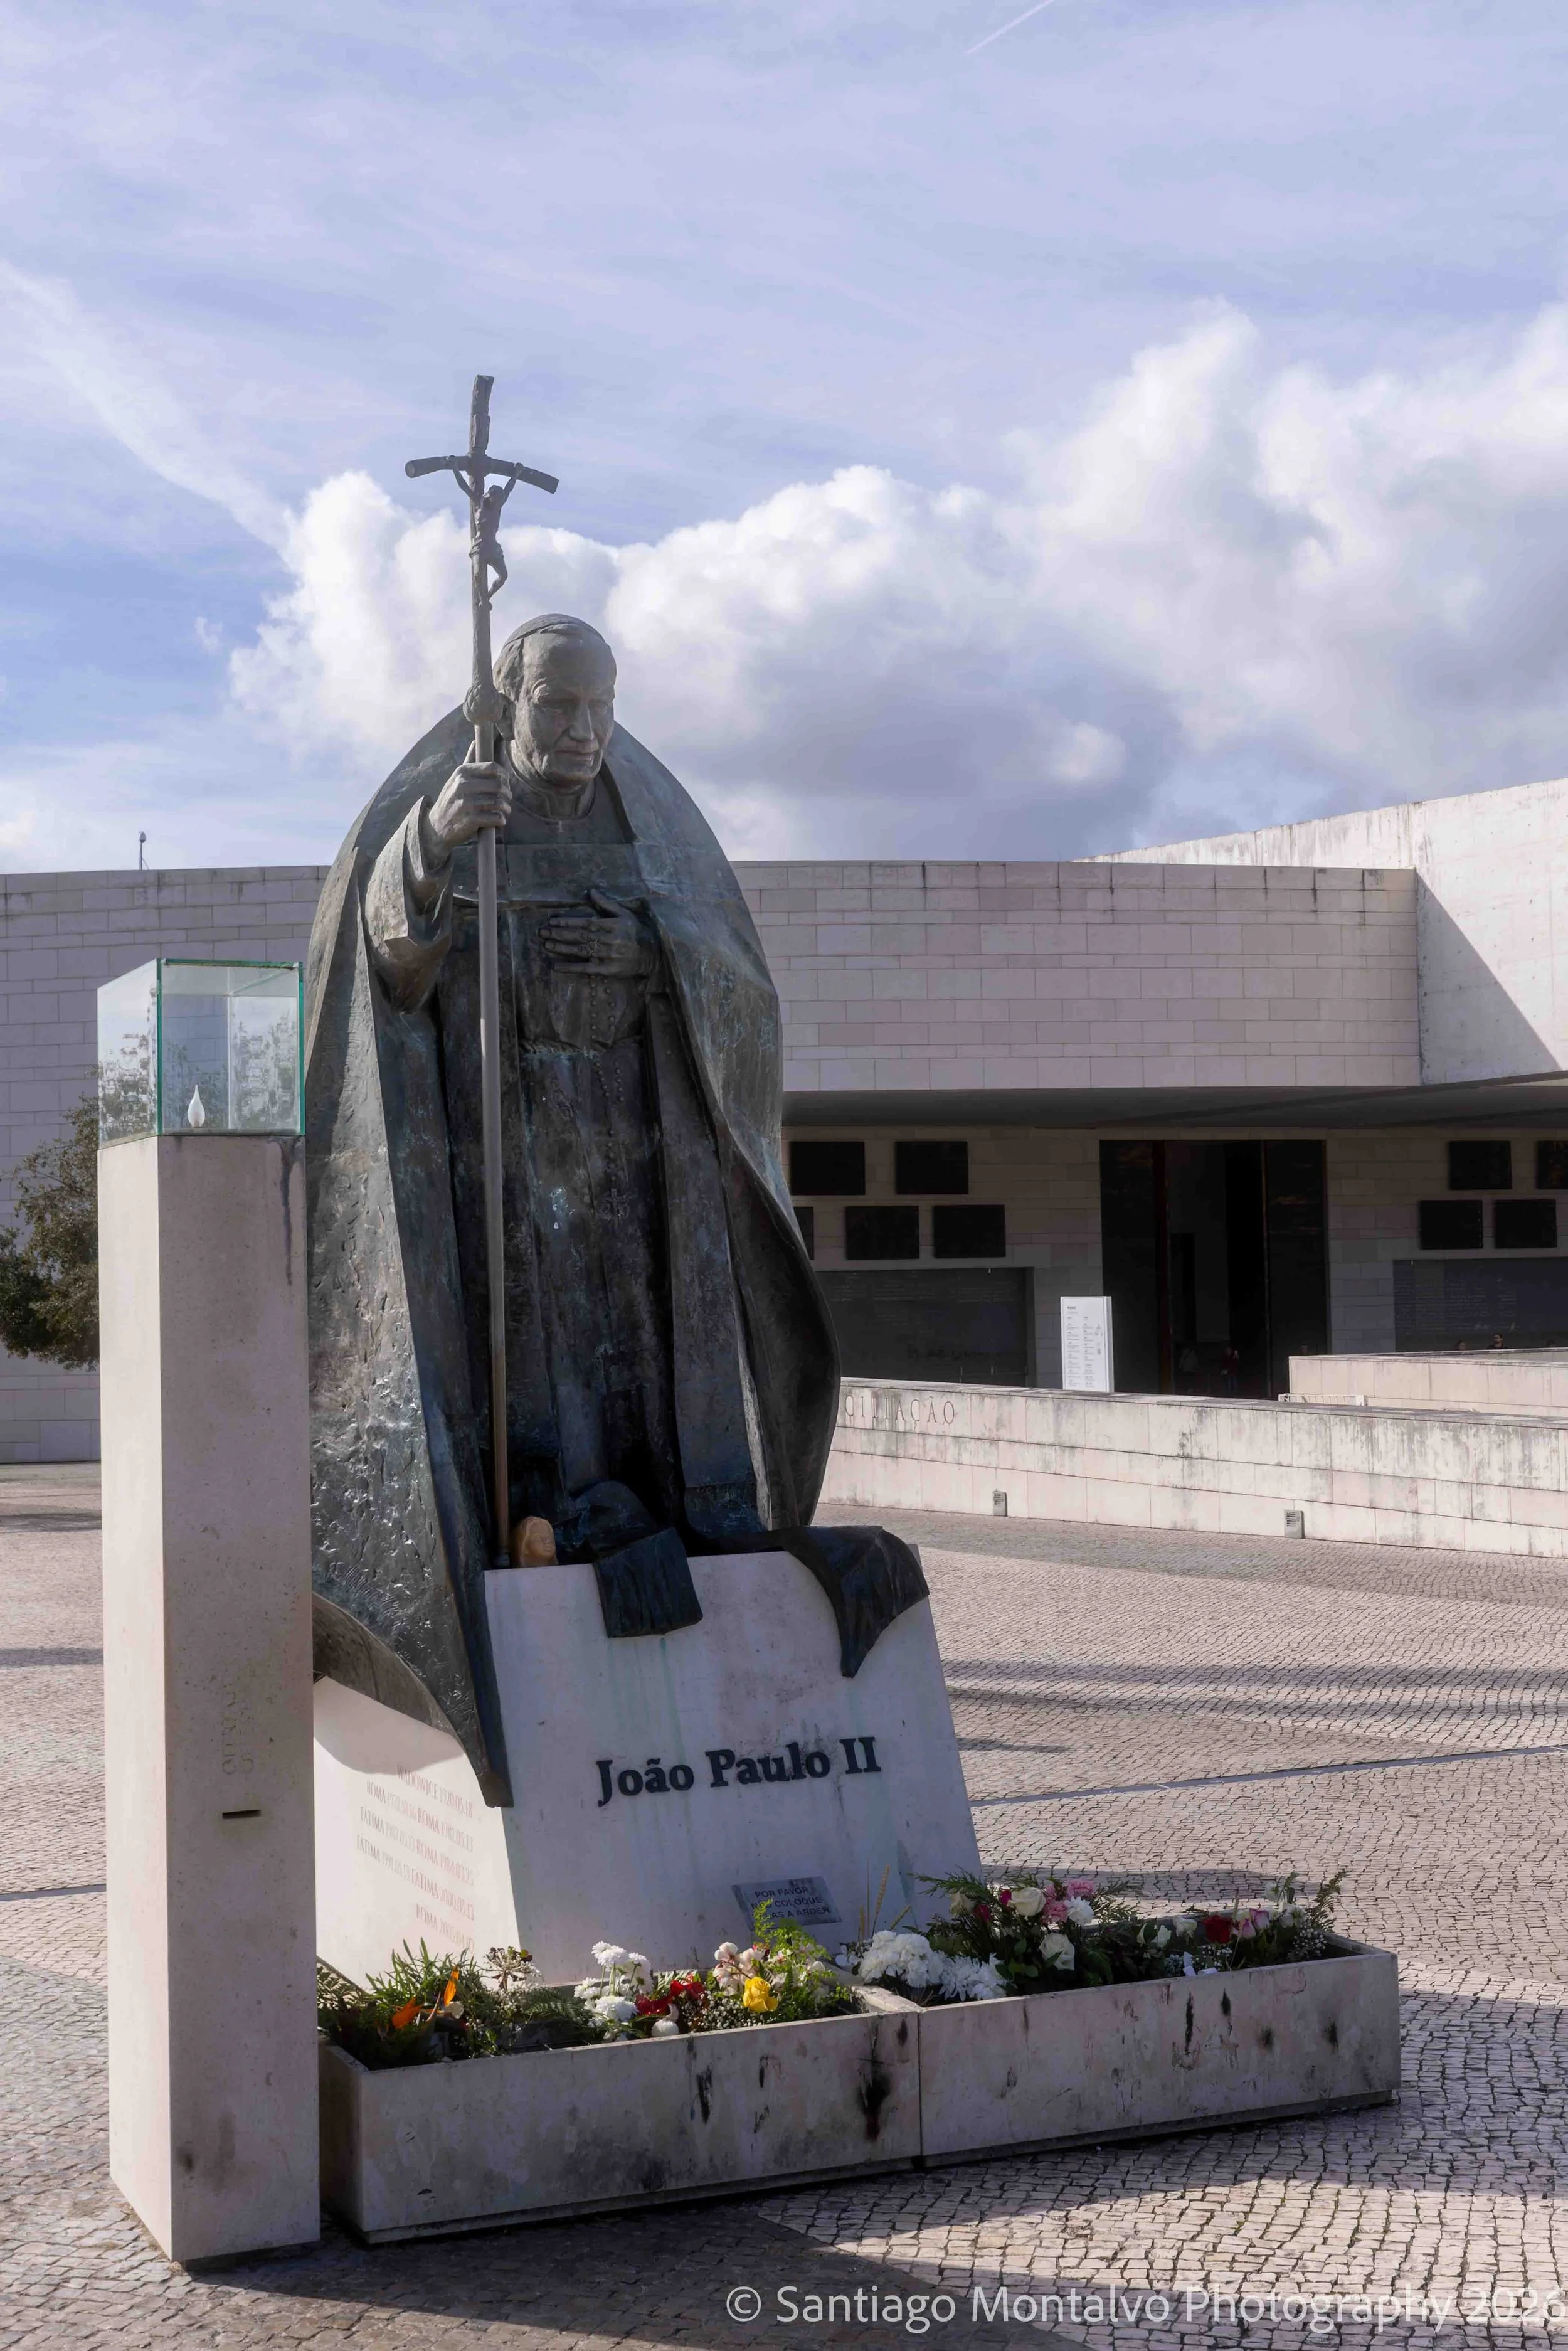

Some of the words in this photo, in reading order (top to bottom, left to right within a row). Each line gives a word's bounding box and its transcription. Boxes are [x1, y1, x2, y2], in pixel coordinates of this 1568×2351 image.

[397, 1765, 437, 1799] WADOWICE
[596, 1758, 694, 1807] João
[706, 1741, 831, 1787] Paulo
[839, 1736, 882, 1774] II
[366, 1779, 386, 1804] ROMA
[418, 1807, 440, 1834] ROMA
[416, 1839, 439, 1865] ROMA
[751, 1899, 772, 1909] NO
[774, 1896, 824, 1908] COLOQUE
[755, 1890, 776, 1898] POR
[778, 1886, 810, 1896] FAVOR
[416, 1903, 438, 1931] ROMA
[797, 1906, 830, 1916] ARDER
